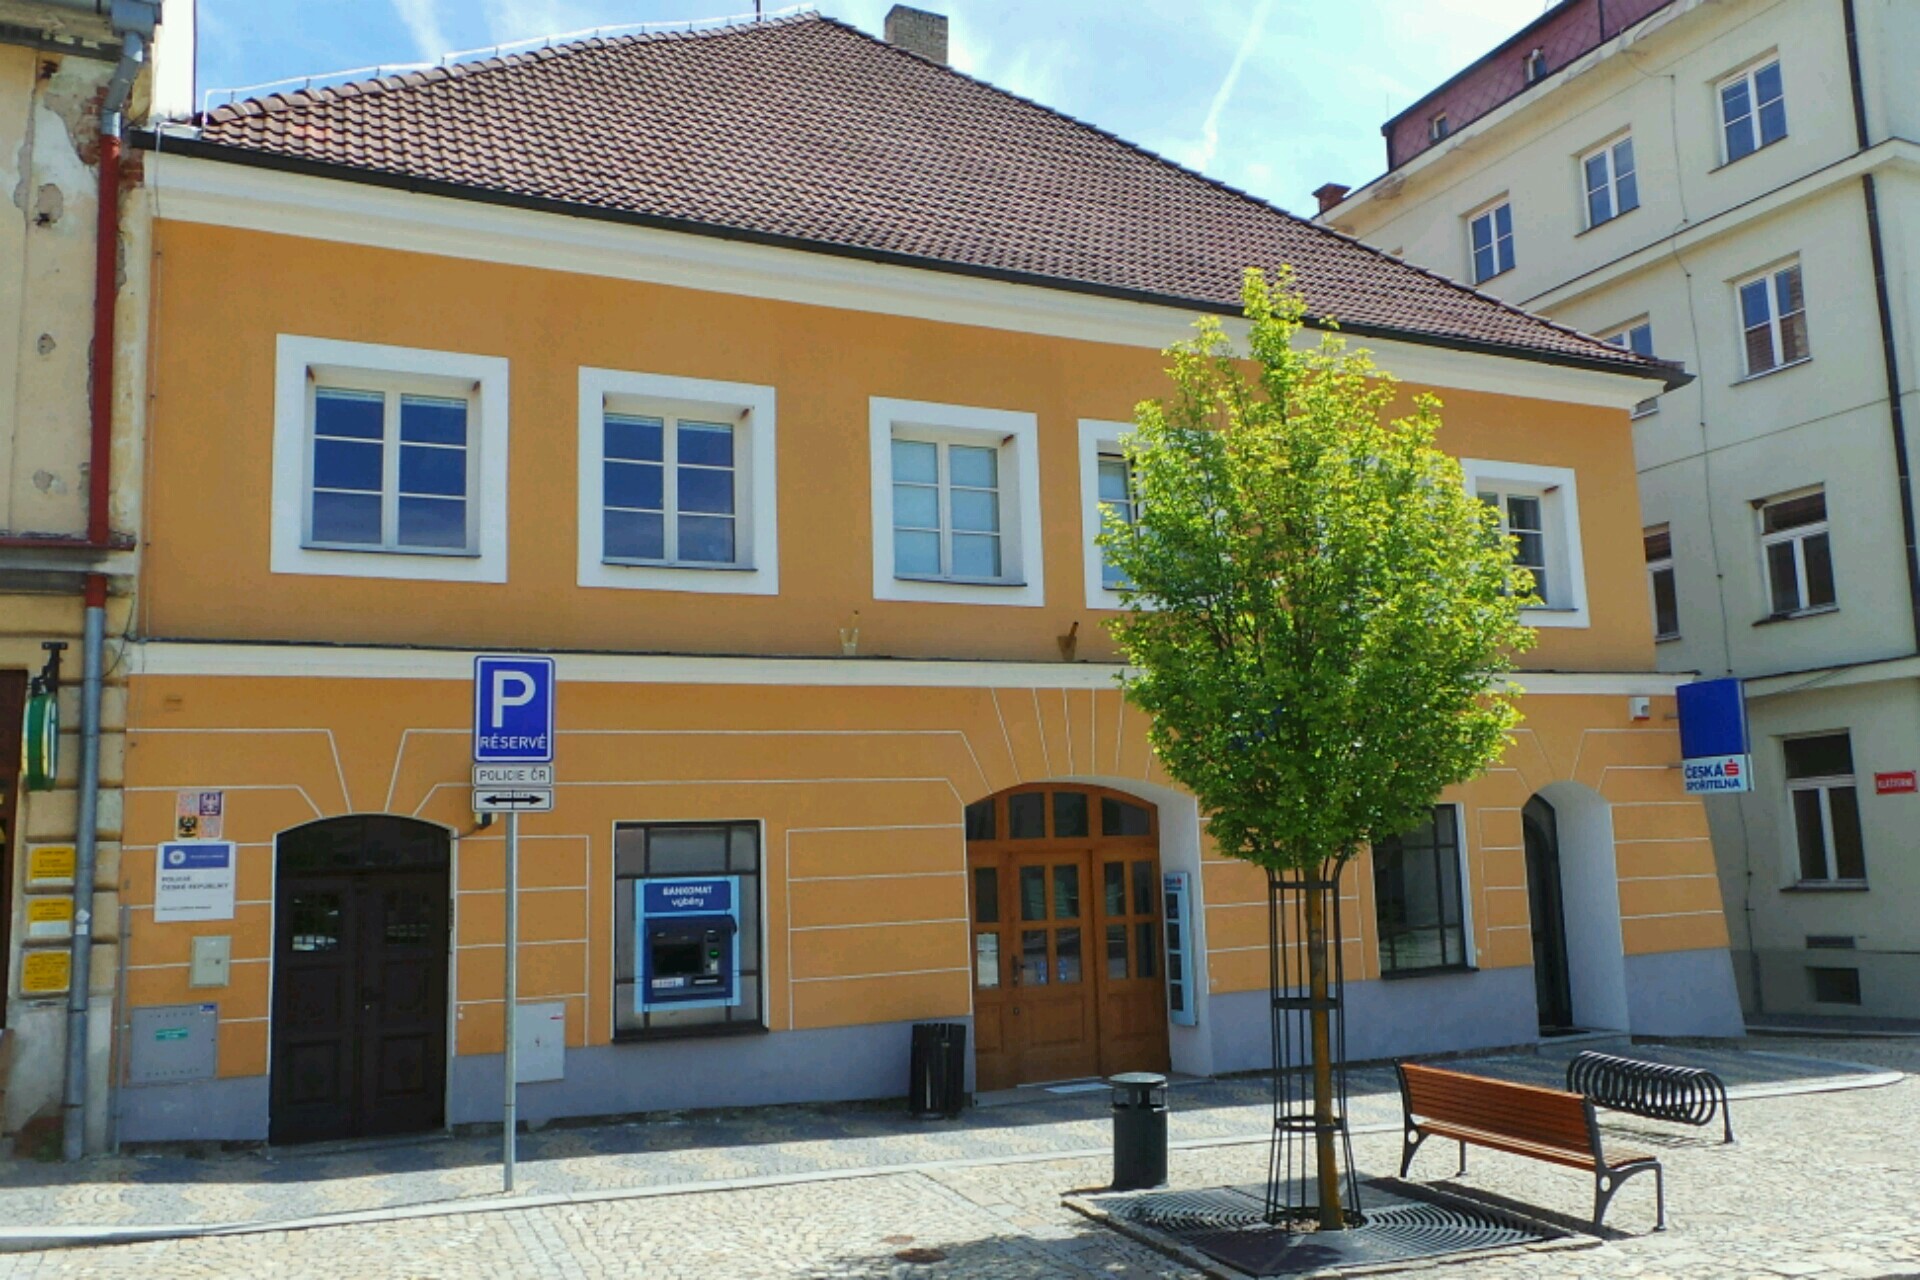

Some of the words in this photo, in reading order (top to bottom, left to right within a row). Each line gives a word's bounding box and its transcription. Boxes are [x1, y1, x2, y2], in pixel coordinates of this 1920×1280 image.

[492, 669, 536, 728] P
[480, 732, 547, 749] RÉSERVÉ
[480, 769, 526, 781] POLICIE
[531, 767, 546, 781] ČR
[1685, 761, 1724, 779] ČESKÁ
[1686, 778, 1741, 791] SPOŘITELNA
[663, 886, 713, 896] BANKOMAT
[671, 896, 704, 907] výběry
